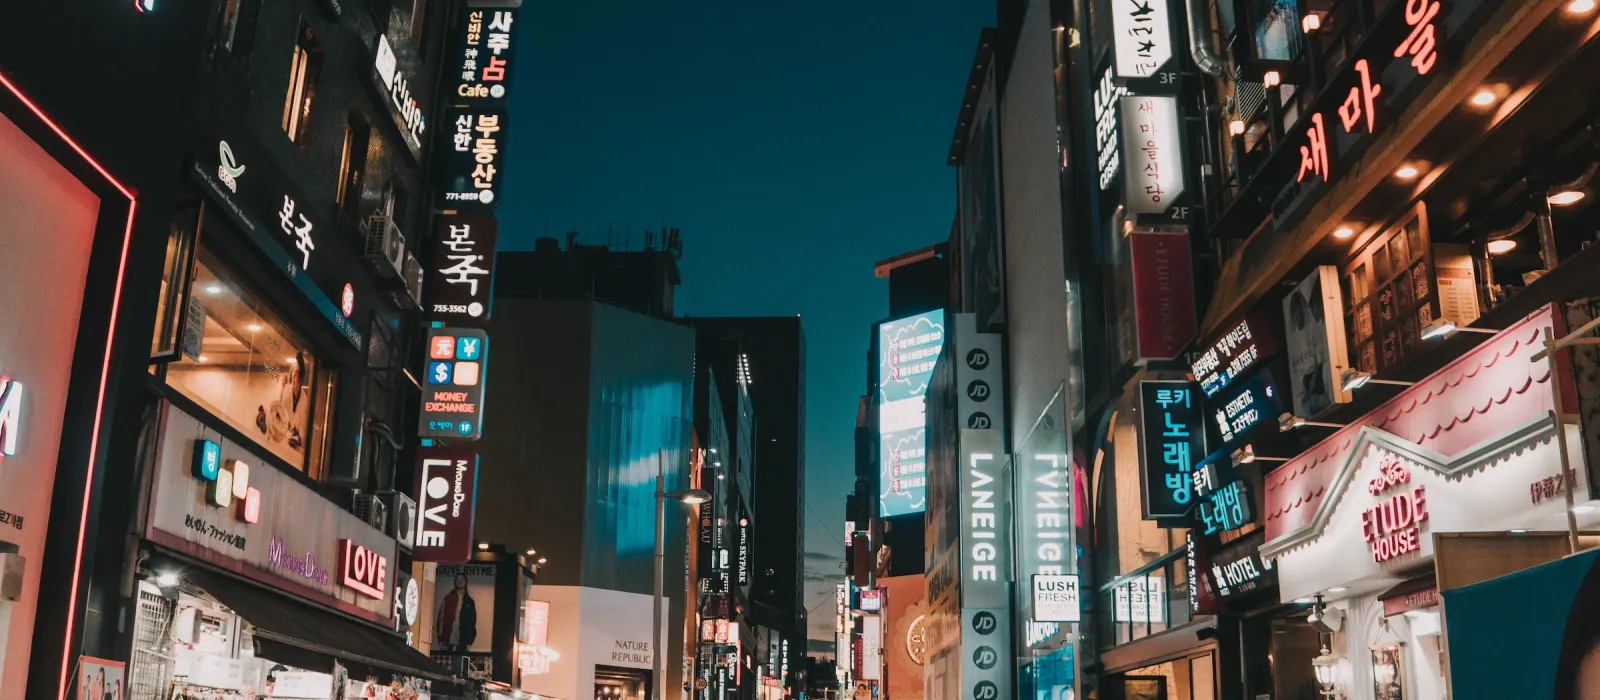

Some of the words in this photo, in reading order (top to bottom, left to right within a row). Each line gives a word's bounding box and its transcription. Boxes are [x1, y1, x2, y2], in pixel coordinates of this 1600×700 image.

[467, 11, 483, 45] 신비안
[458, 84, 489, 97] Cafe
[1159, 72, 1176, 84] 3F
[393, 71, 425, 149] 신비안
[453, 115, 473, 152] 신한
[472, 115, 500, 189] 부동산
[1137, 100, 1164, 203] 새마을식당
[1171, 206, 1189, 219] 2F
[279, 194, 315, 271] 본죽
[438, 223, 490, 297] 본죽
[1156, 249, 1171, 293] ETUDE
[1161, 297, 1175, 344] HOUSE
[436, 339, 453, 357] 元
[969, 353, 987, 366] JD
[434, 391, 468, 402] MONEY
[969, 384, 989, 398] JD
[1156, 388, 1191, 409] 루키
[425, 402, 475, 413] EXCHANGE
[1225, 389, 1255, 419] ESTHETIC
[428, 421, 453, 431] 오케이
[461, 423, 470, 432] 1F
[970, 416, 990, 428] JD
[1162, 412, 1193, 504] 노래방
[1192, 464, 1213, 497] 루키
[416, 459, 453, 547] LOVE
[1200, 482, 1244, 536] 노래방
[1361, 486, 1428, 543] ETUDE
[970, 453, 996, 582] LANEIGE
[1371, 527, 1420, 563] HOUSE
[343, 538, 386, 601] LOVE
[738, 545, 747, 583] SKYPARK
[1223, 555, 1260, 587] HOTEL
[1038, 581, 1076, 592] LUSH
[1038, 592, 1077, 602] FRESH
[1409, 590, 1432, 607] ETUDE
[976, 616, 995, 629] JD
[611, 651, 652, 664] REPUBLIC
[615, 640, 649, 652] NATURE
[977, 651, 996, 665] JD
[977, 686, 997, 699] JD
